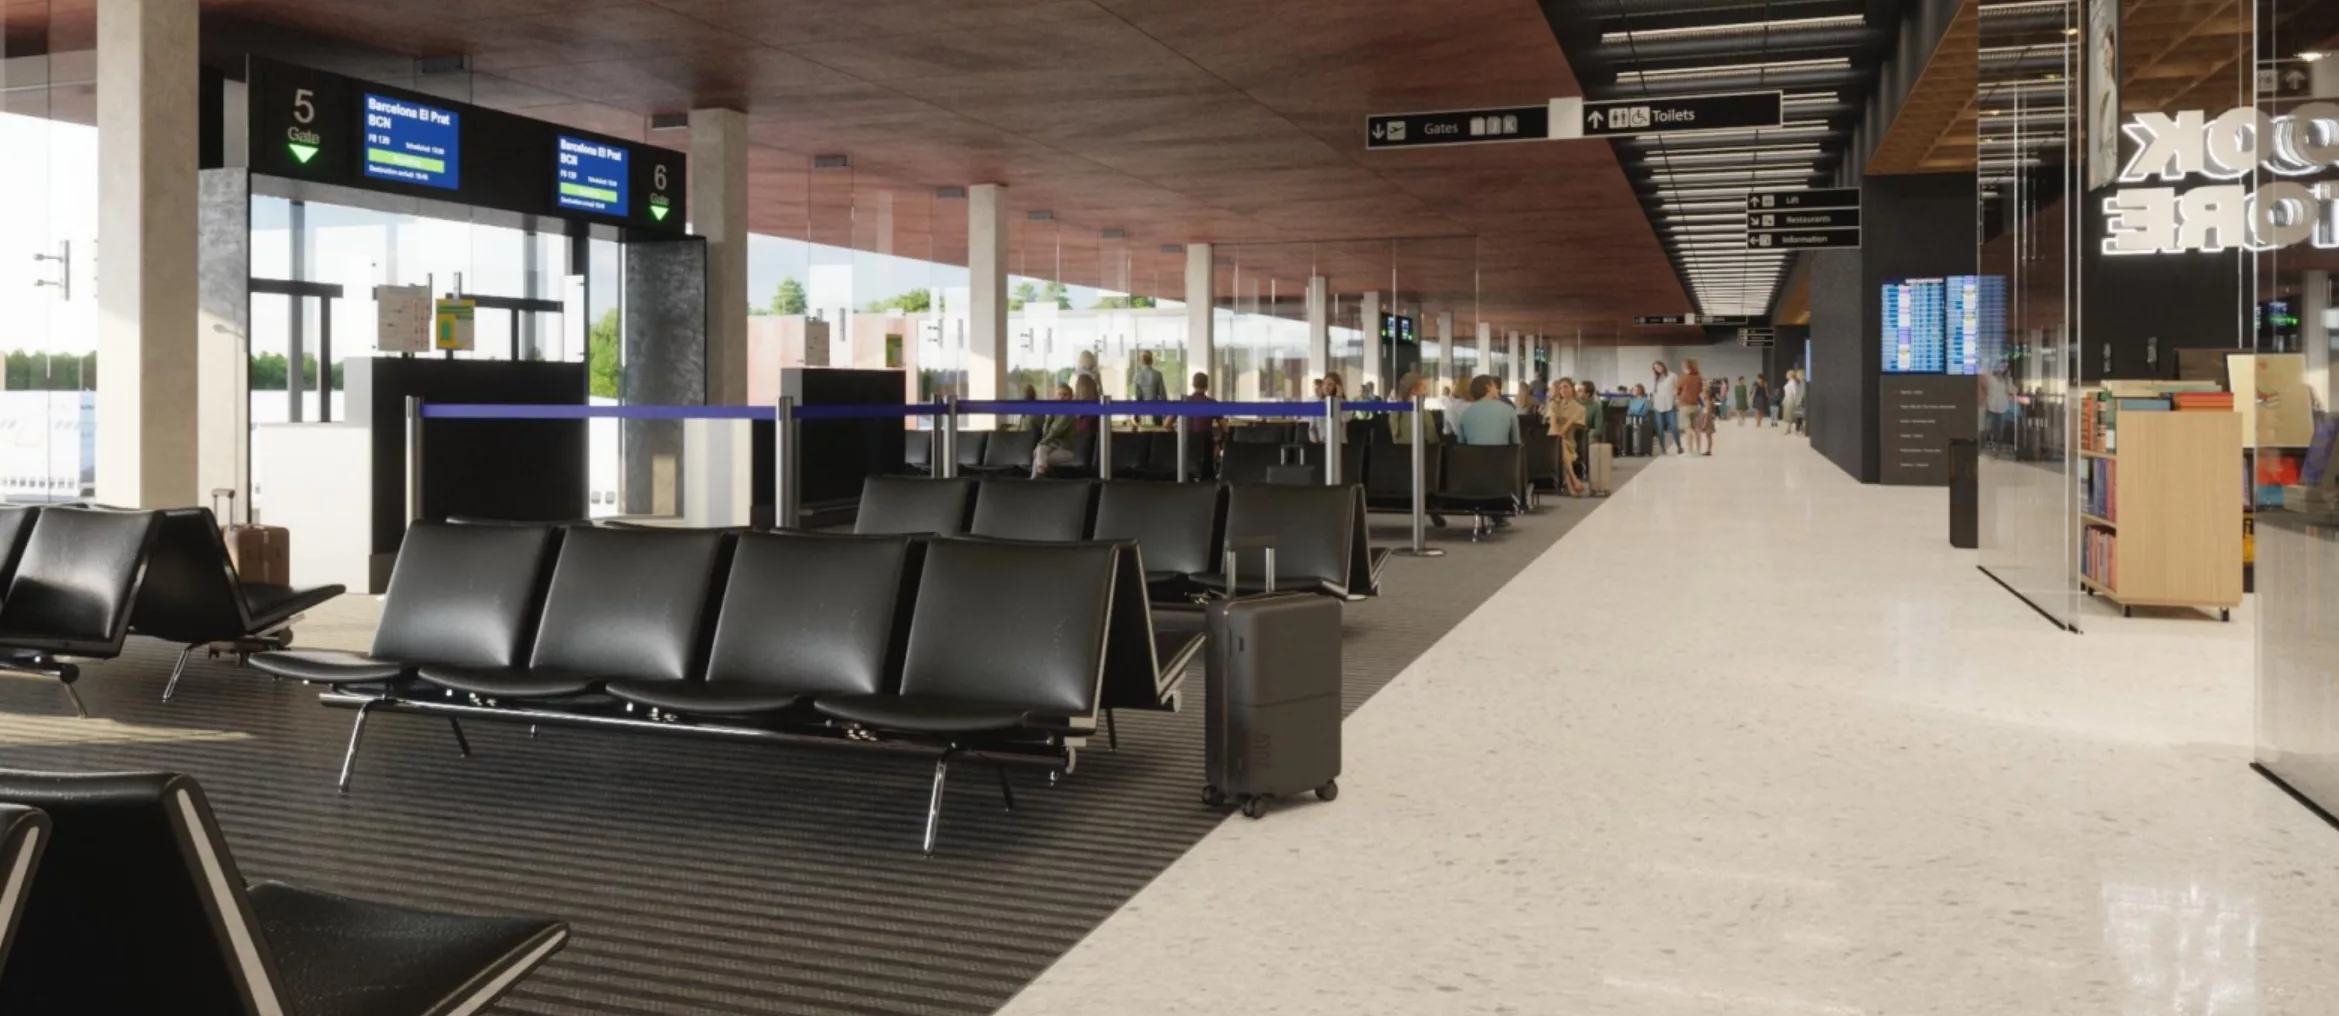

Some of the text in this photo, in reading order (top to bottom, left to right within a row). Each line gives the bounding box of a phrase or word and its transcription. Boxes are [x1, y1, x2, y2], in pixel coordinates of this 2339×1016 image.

[294, 88, 315, 124] 5
[368, 97, 418, 120] Barcelona
[430, 110, 450, 126] Prat
[368, 113, 392, 130] BCN
[1652, 108, 1695, 123] Toilets
[287, 126, 320, 145] Gate
[1424, 122, 1459, 135] Gates
[653, 164, 668, 191] 6
[1785, 195, 1800, 205] Lift
[1785, 215, 1832, 225] Restaurants
[1782, 235, 1828, 245] Information
